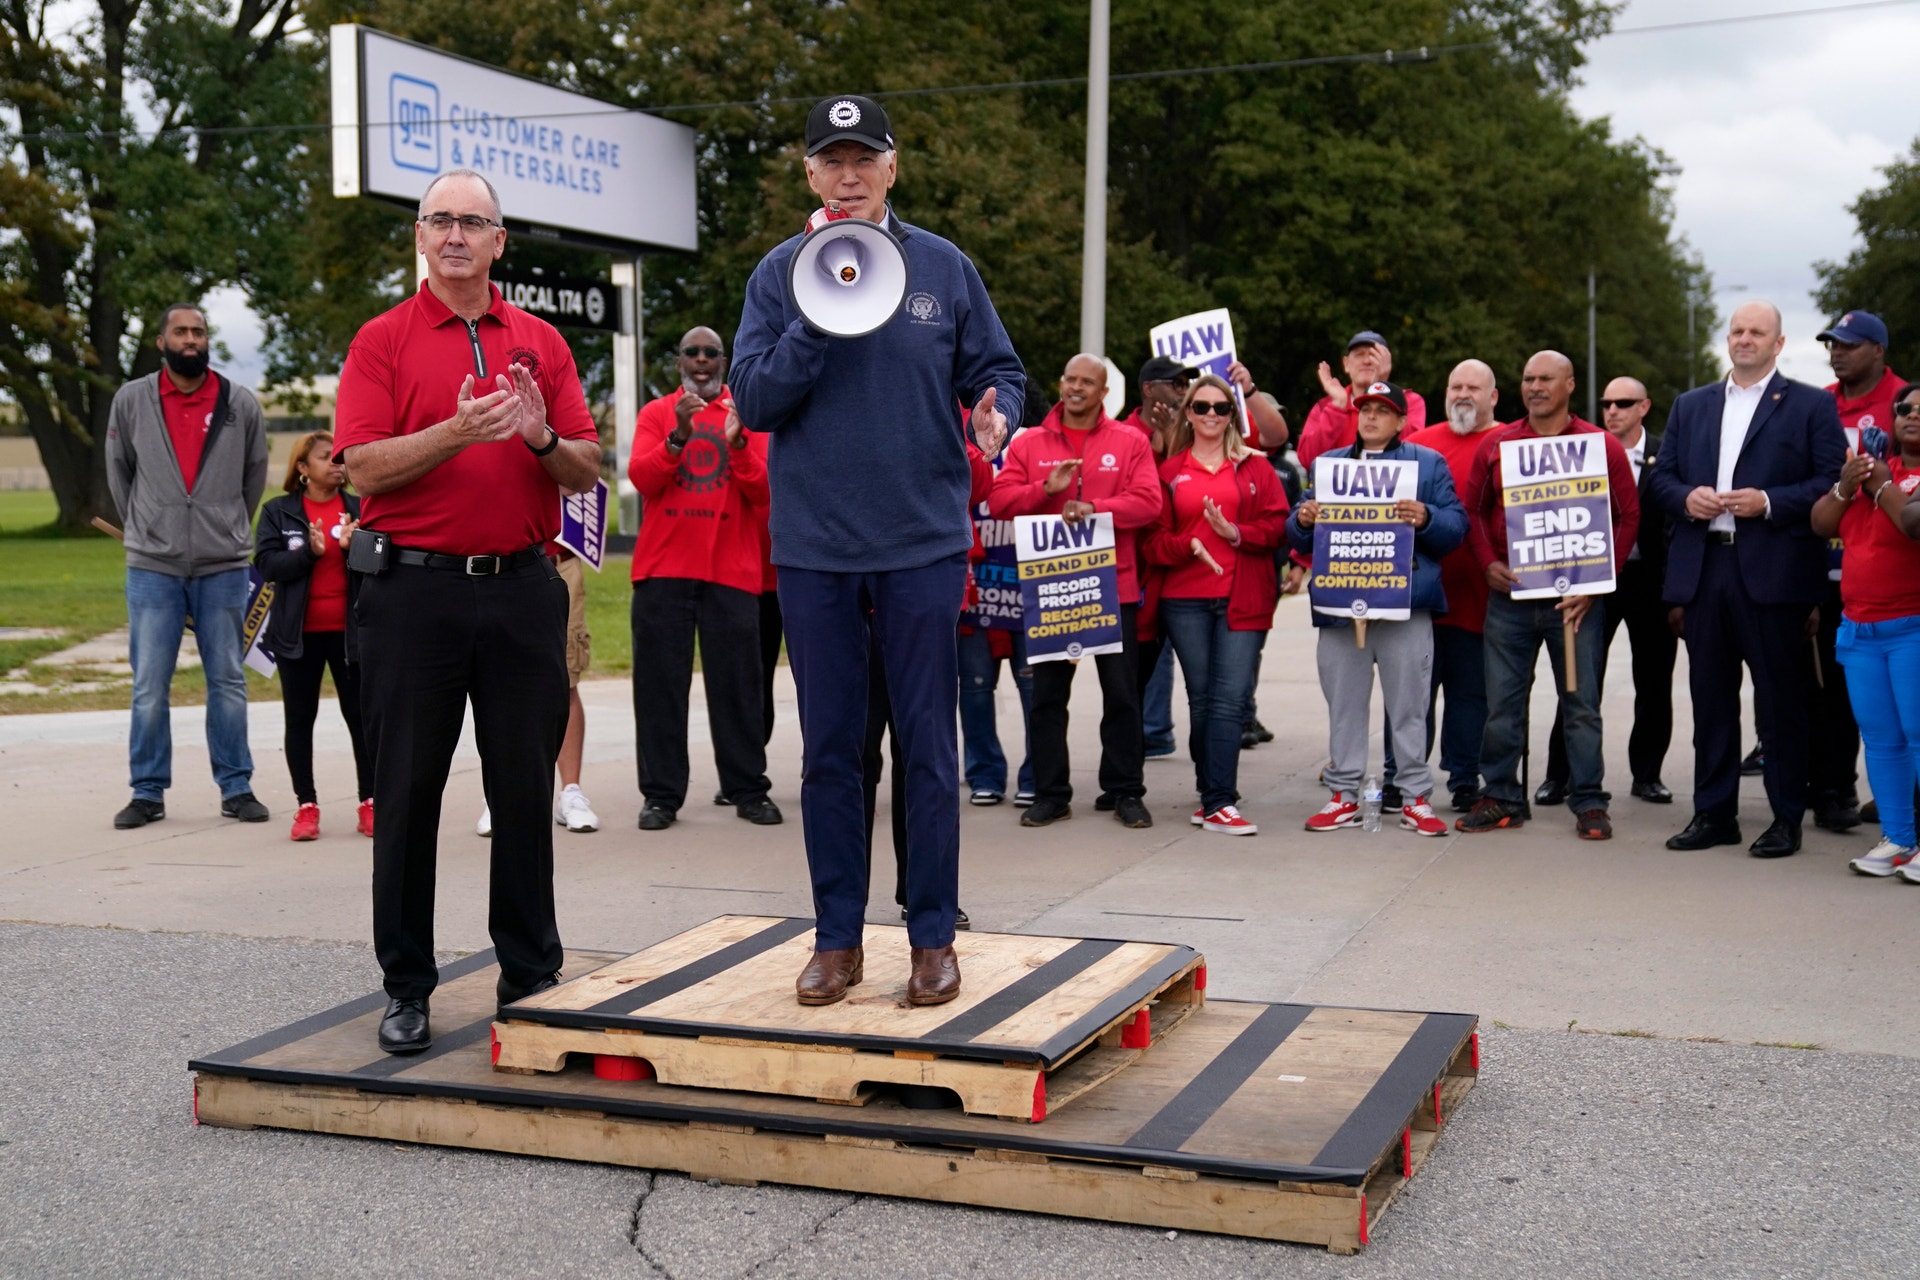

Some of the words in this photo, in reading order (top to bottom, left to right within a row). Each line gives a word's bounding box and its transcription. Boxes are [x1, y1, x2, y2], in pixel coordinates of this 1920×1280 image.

[400, 100, 431, 145] gm
[450, 103, 563, 155] CUSTOMER
[571, 134, 620, 169] CARE
[452, 138, 464, 165] &
[472, 144, 602, 194] AFTERSALES
[506, 281, 558, 313] LOCAL
[558, 288, 584, 317] 174
[1157, 322, 1224, 360] UAW
[1518, 440, 1587, 477] UAW
[1332, 463, 1402, 498] UAW
[1510, 484, 1570, 503] STAND
[1577, 481, 1601, 494] UP
[1321, 507, 1379, 520] STAND
[1385, 508, 1401, 519] U
[1524, 506, 1592, 537] END
[1032, 518, 1096, 552] UAW
[1330, 531, 1396, 544] RECORD
[1512, 531, 1607, 564] TIERS
[1329, 545, 1395, 559] PROFITS
[1025, 558, 1082, 577] STAND
[1087, 553, 1110, 566] UP
[1329, 562, 1394, 574] RECORD
[1038, 576, 1101, 596] RECORD
[1314, 575, 1408, 589] CONTRACTS
[1039, 588, 1102, 609] PROFITS
[1028, 614, 1118, 639] CONTRACTS
[1040, 604, 1103, 624] RECORD
